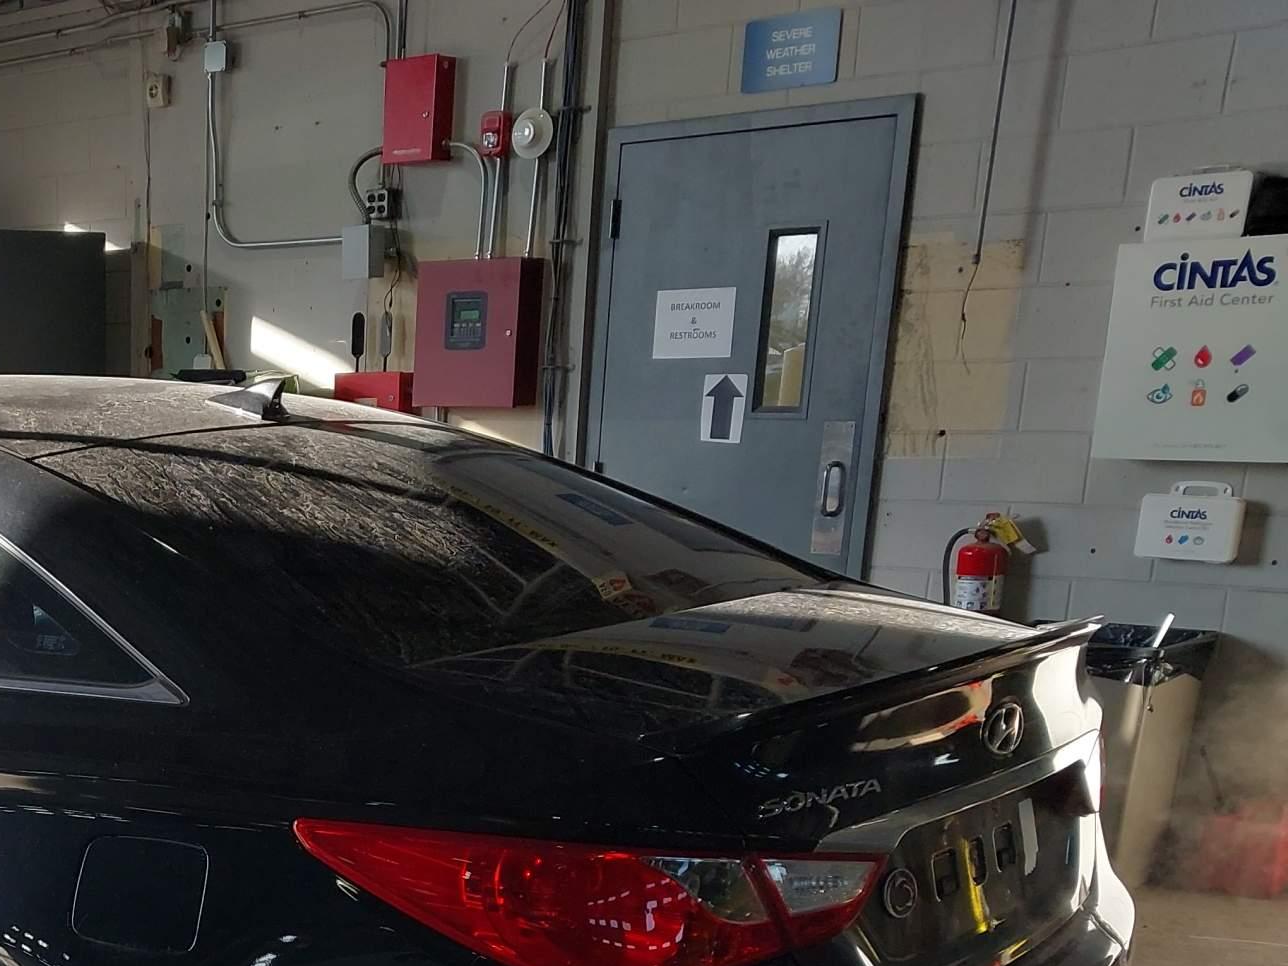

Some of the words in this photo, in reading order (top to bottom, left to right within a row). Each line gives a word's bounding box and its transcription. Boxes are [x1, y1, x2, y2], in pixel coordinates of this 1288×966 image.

[772, 26, 813, 42] SEVERE
[766, 43, 816, 60] WEATHER
[765, 61, 813, 77] SHELTER
[670, 301, 721, 312] BREAKROOM
[1151, 296, 1182, 308] First
[1188, 294, 1215, 307] Aid
[1220, 293, 1273, 306] Center
[691, 316, 697, 325] &
[669, 330, 717, 340] RESTROOMS
[758, 779, 882, 819] SONATA
